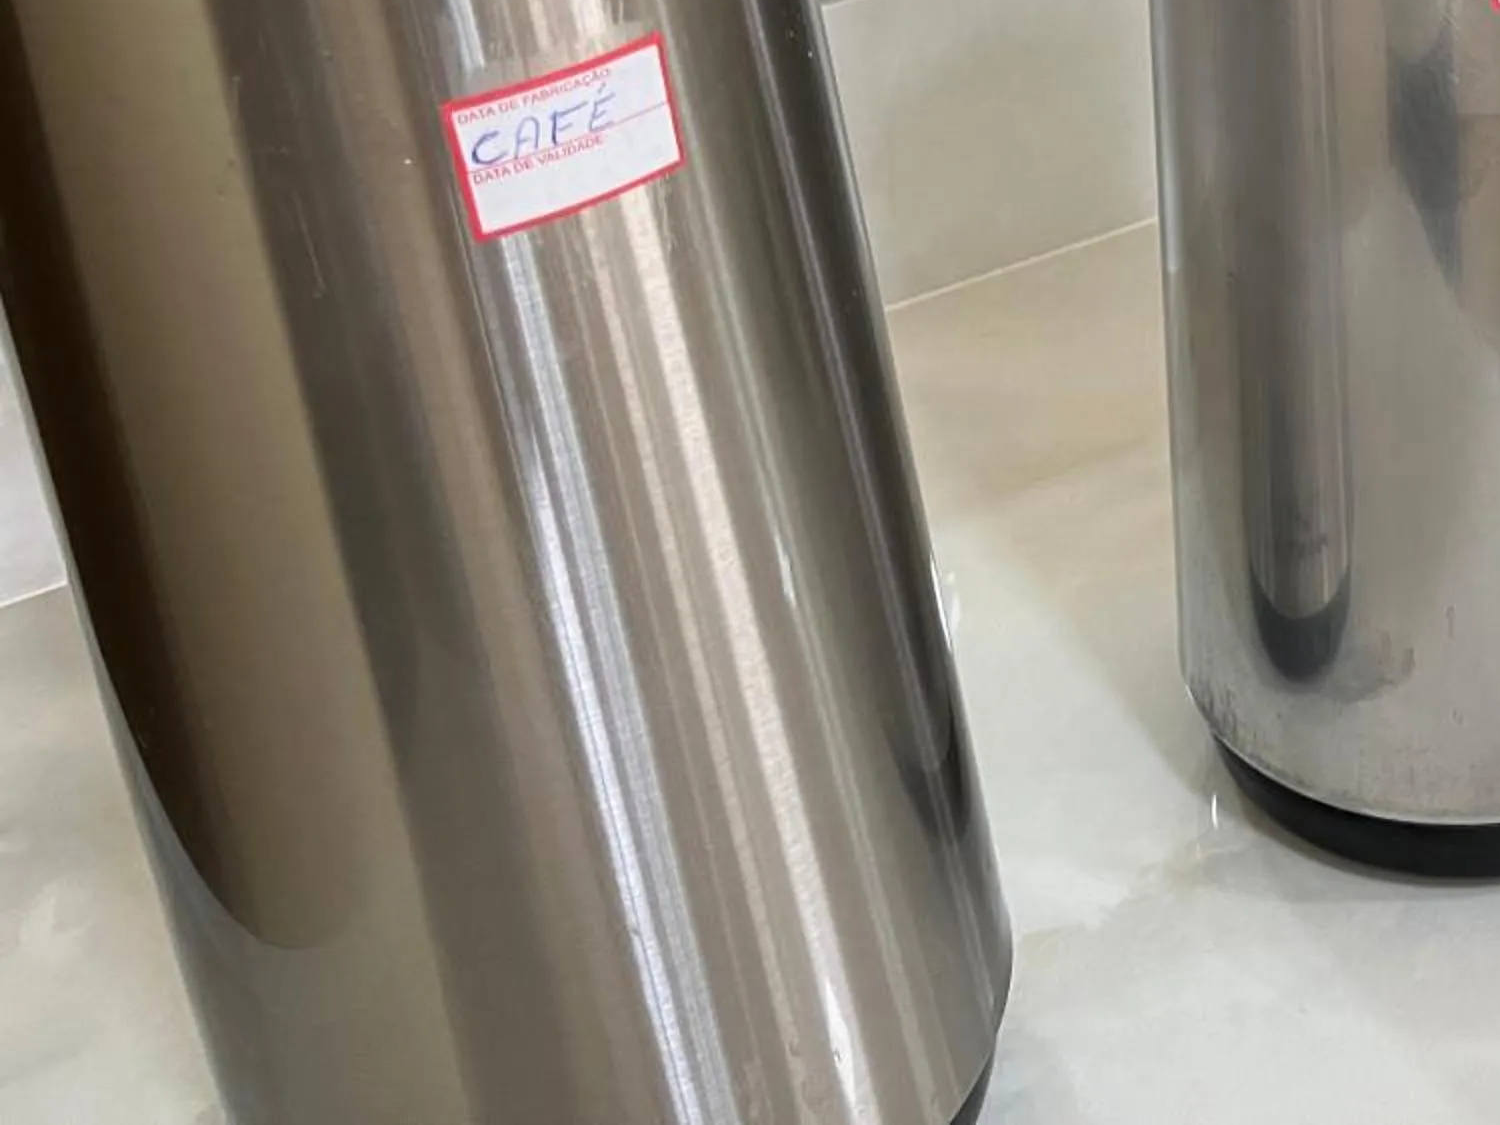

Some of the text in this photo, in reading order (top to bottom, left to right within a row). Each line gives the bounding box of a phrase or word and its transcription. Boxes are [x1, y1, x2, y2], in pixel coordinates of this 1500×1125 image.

[457, 107, 497, 125] DATA
[498, 98, 517, 113] DE
[471, 82, 616, 166] CAFÉ
[473, 134, 604, 186] DATA DE VALIDADE
